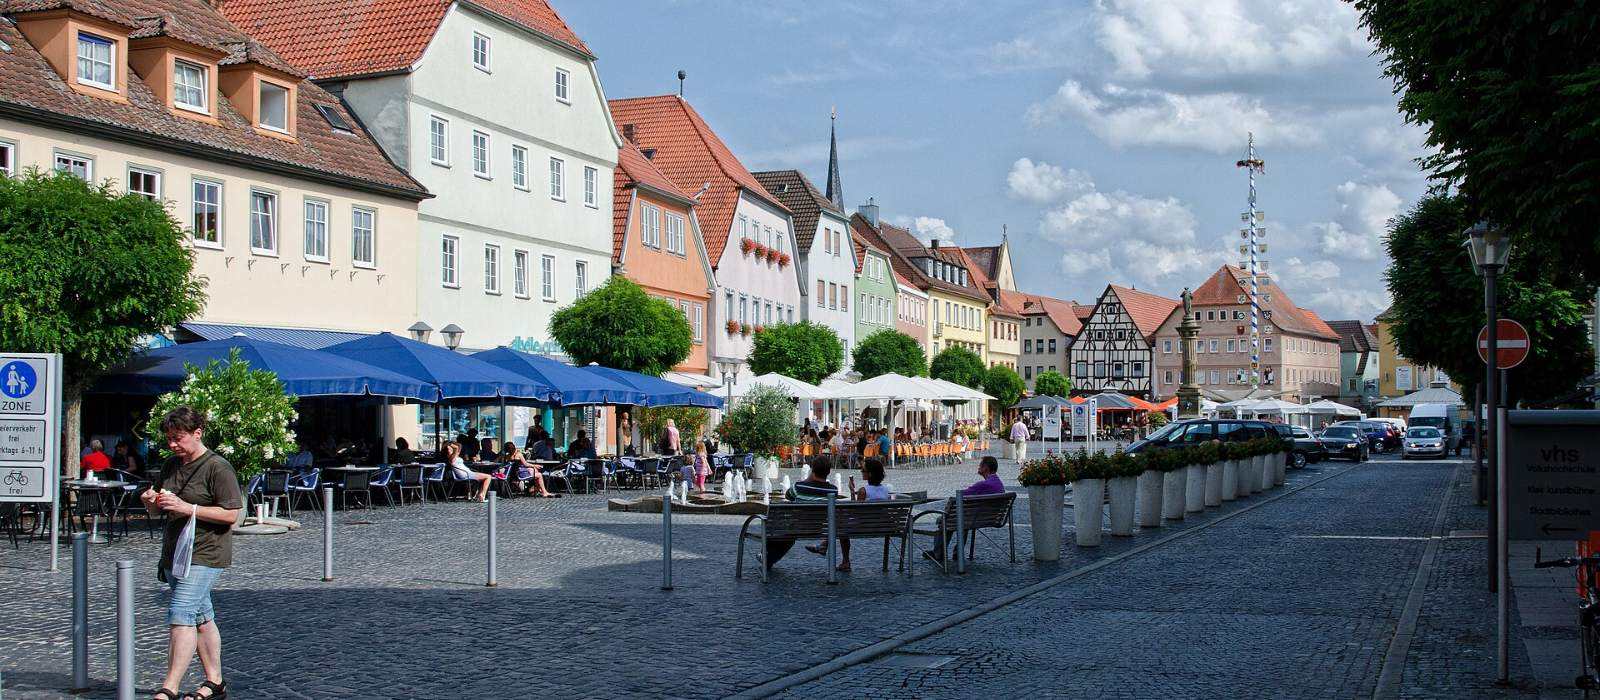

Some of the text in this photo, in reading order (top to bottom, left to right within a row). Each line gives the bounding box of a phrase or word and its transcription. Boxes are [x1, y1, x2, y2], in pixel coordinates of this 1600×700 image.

[2, 401, 32, 411] ZONE
[8, 434, 20, 442] frei
[21, 446, 35, 455] 6-11
[37, 446, 42, 455] h
[1540, 443, 1580, 463] vhs
[9, 486, 23, 494] frei
